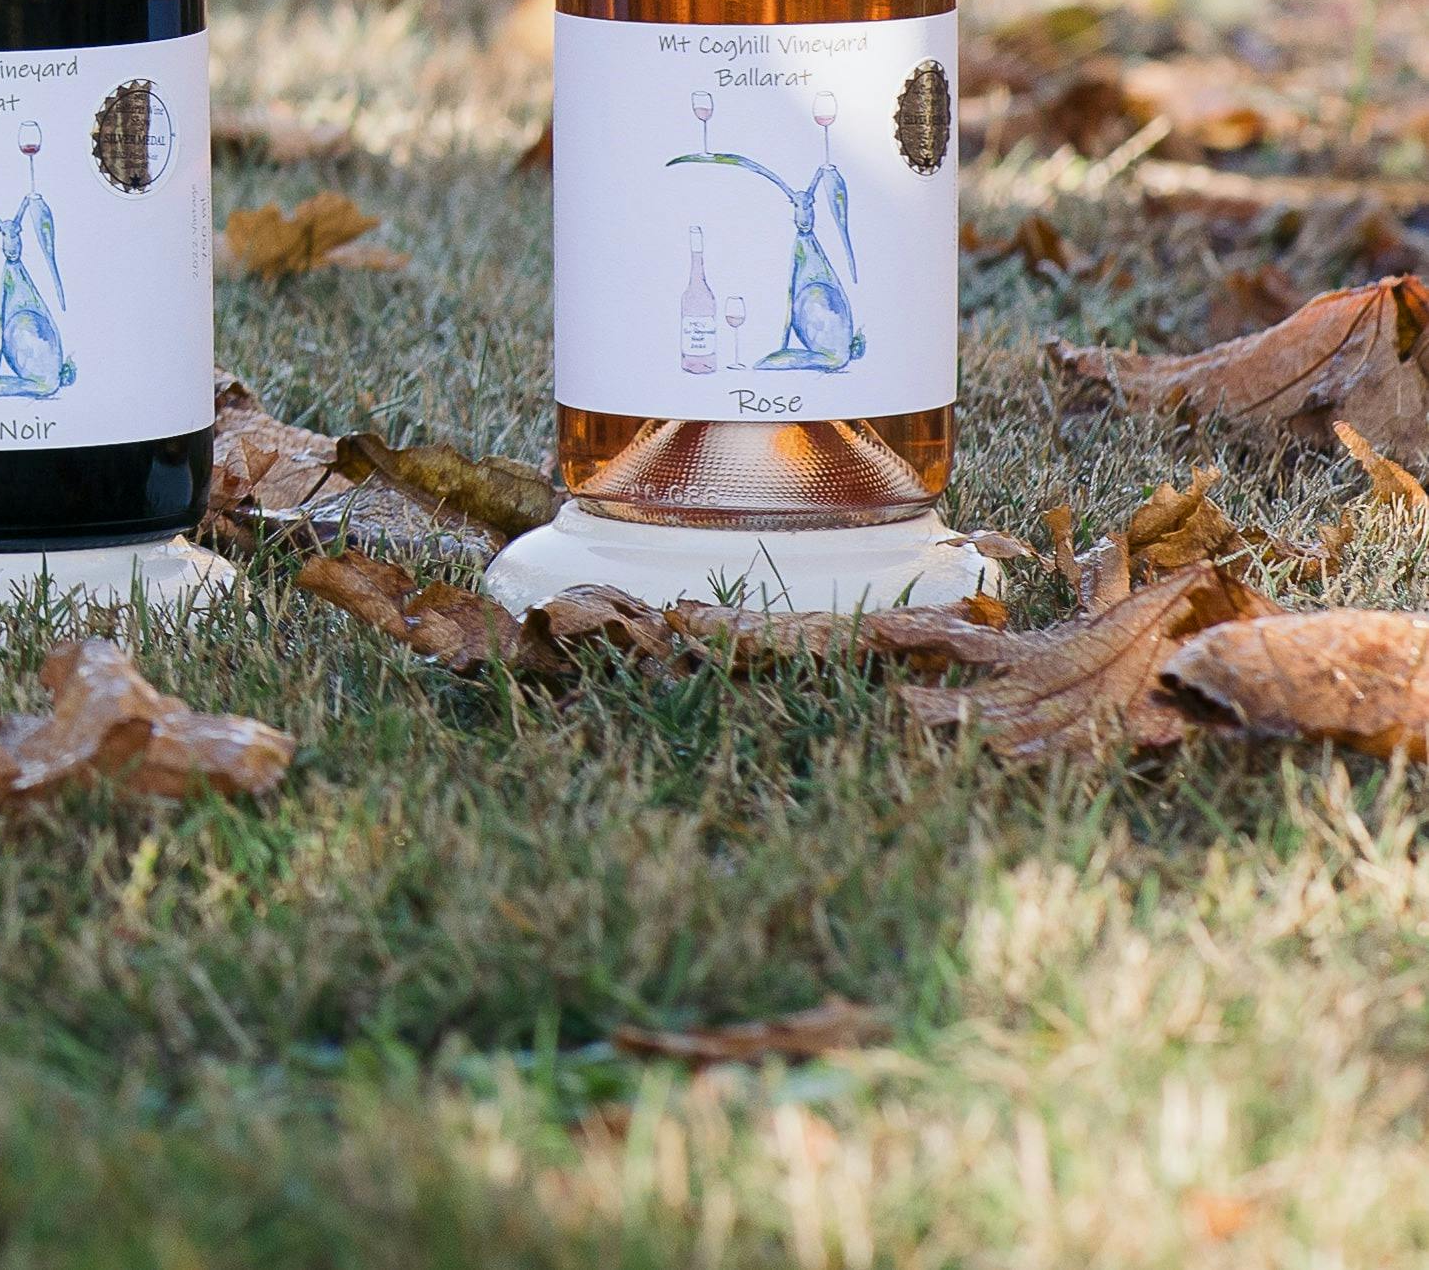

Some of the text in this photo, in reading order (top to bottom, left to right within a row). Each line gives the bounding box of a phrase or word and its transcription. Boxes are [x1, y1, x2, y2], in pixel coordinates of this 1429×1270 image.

[658, 32, 868, 62] Mt Coghill Vineyard
[713, 67, 813, 88] Ballarat
[728, 389, 804, 414] Rose
[0, 416, 57, 441] Noir
